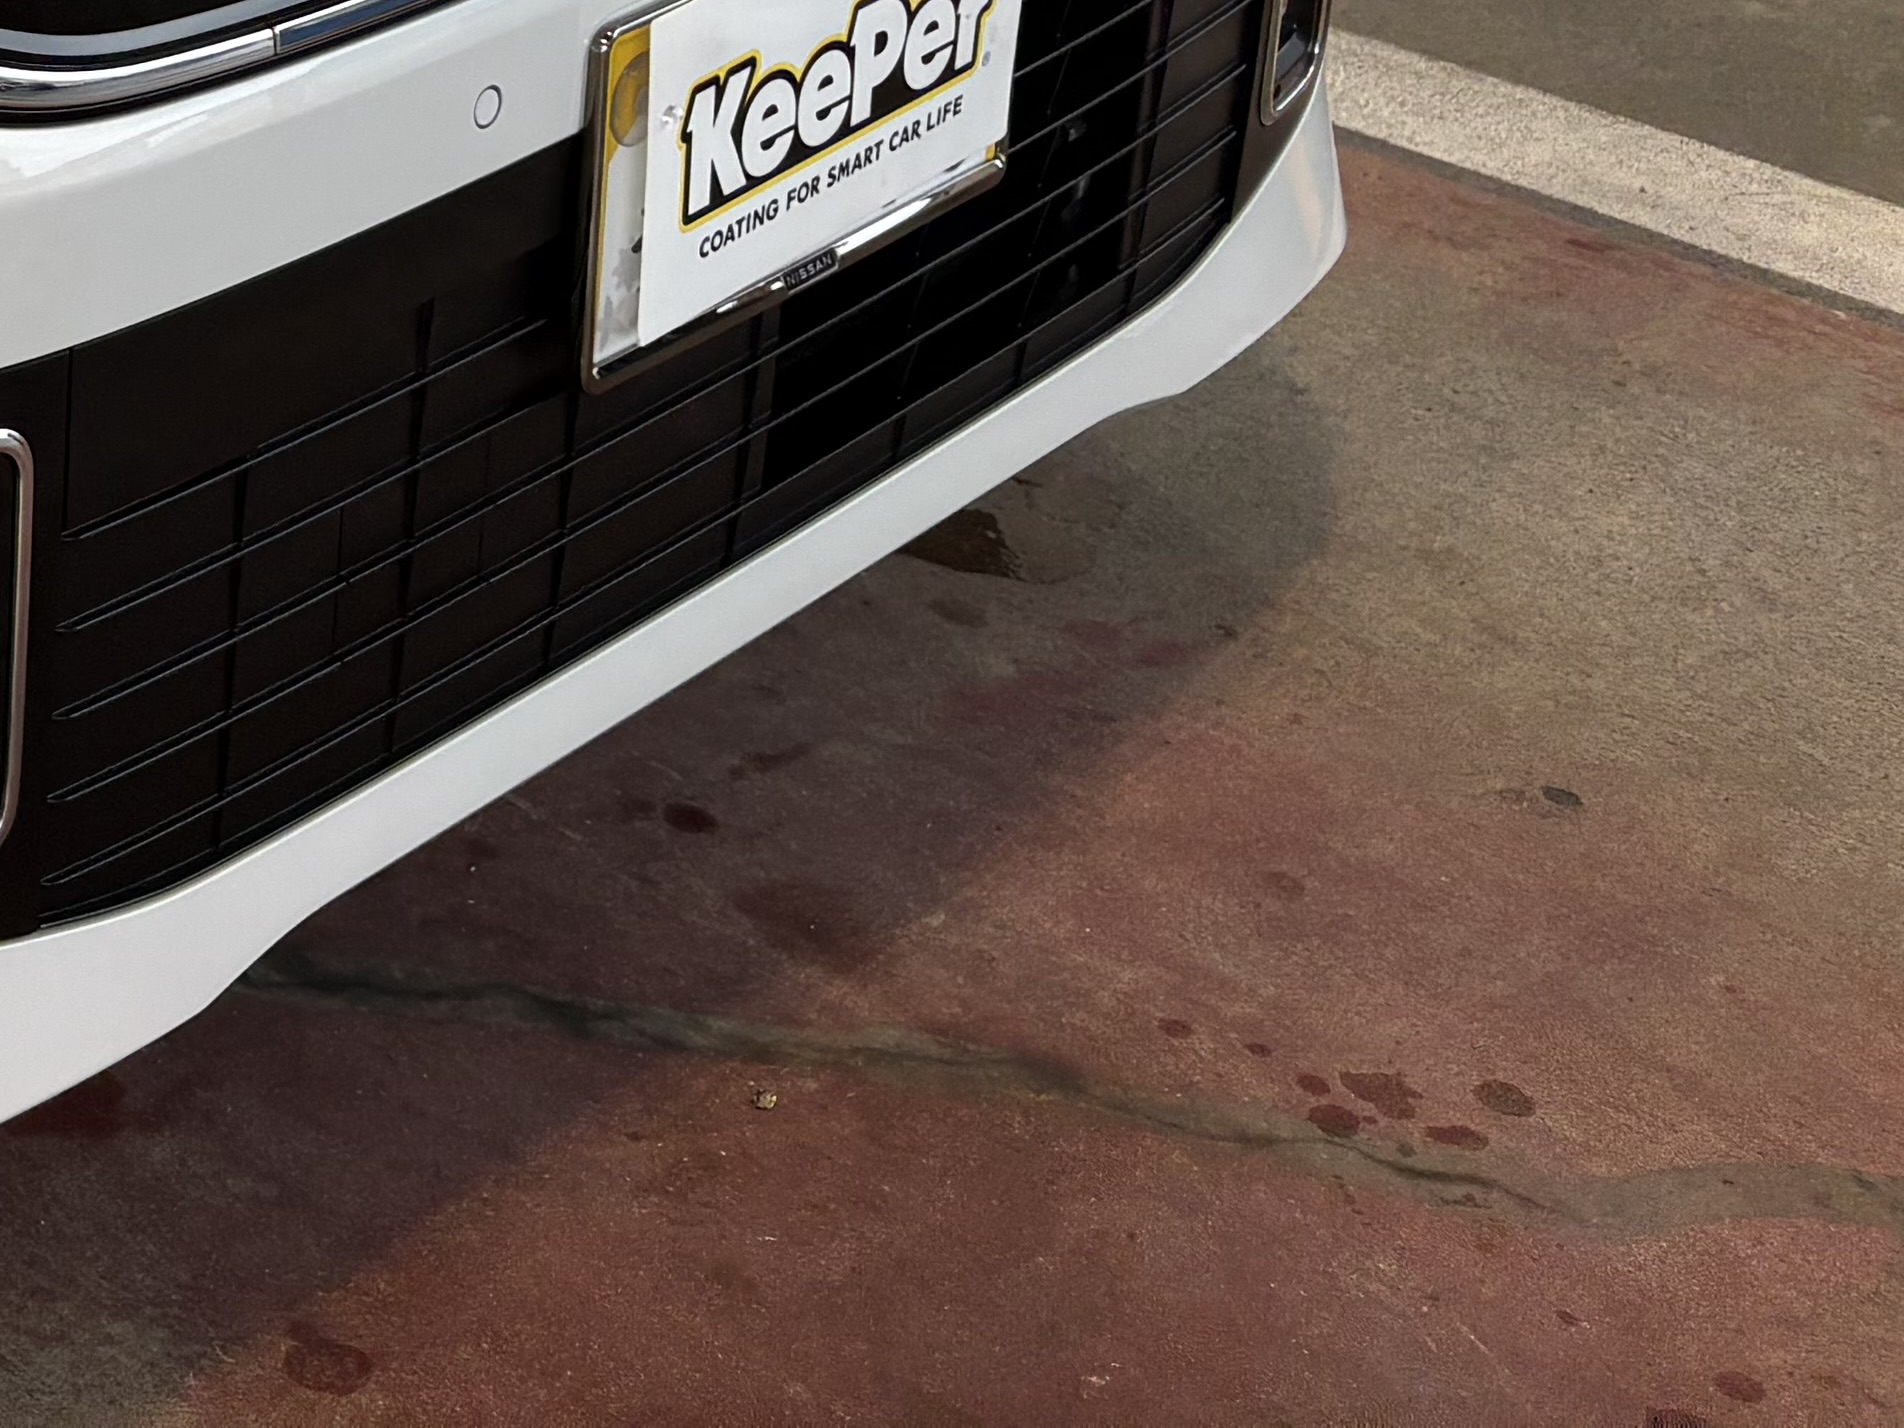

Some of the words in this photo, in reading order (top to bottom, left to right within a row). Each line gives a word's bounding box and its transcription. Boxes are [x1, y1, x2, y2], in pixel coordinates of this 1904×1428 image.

[698, 198, 780, 259] COATING
[786, 177, 821, 212] FOR
[826, 143, 884, 189] SMART
[888, 121, 922, 152] CAR
[926, 95, 965, 133] LIFE
[786, 253, 834, 285] NISSAN
